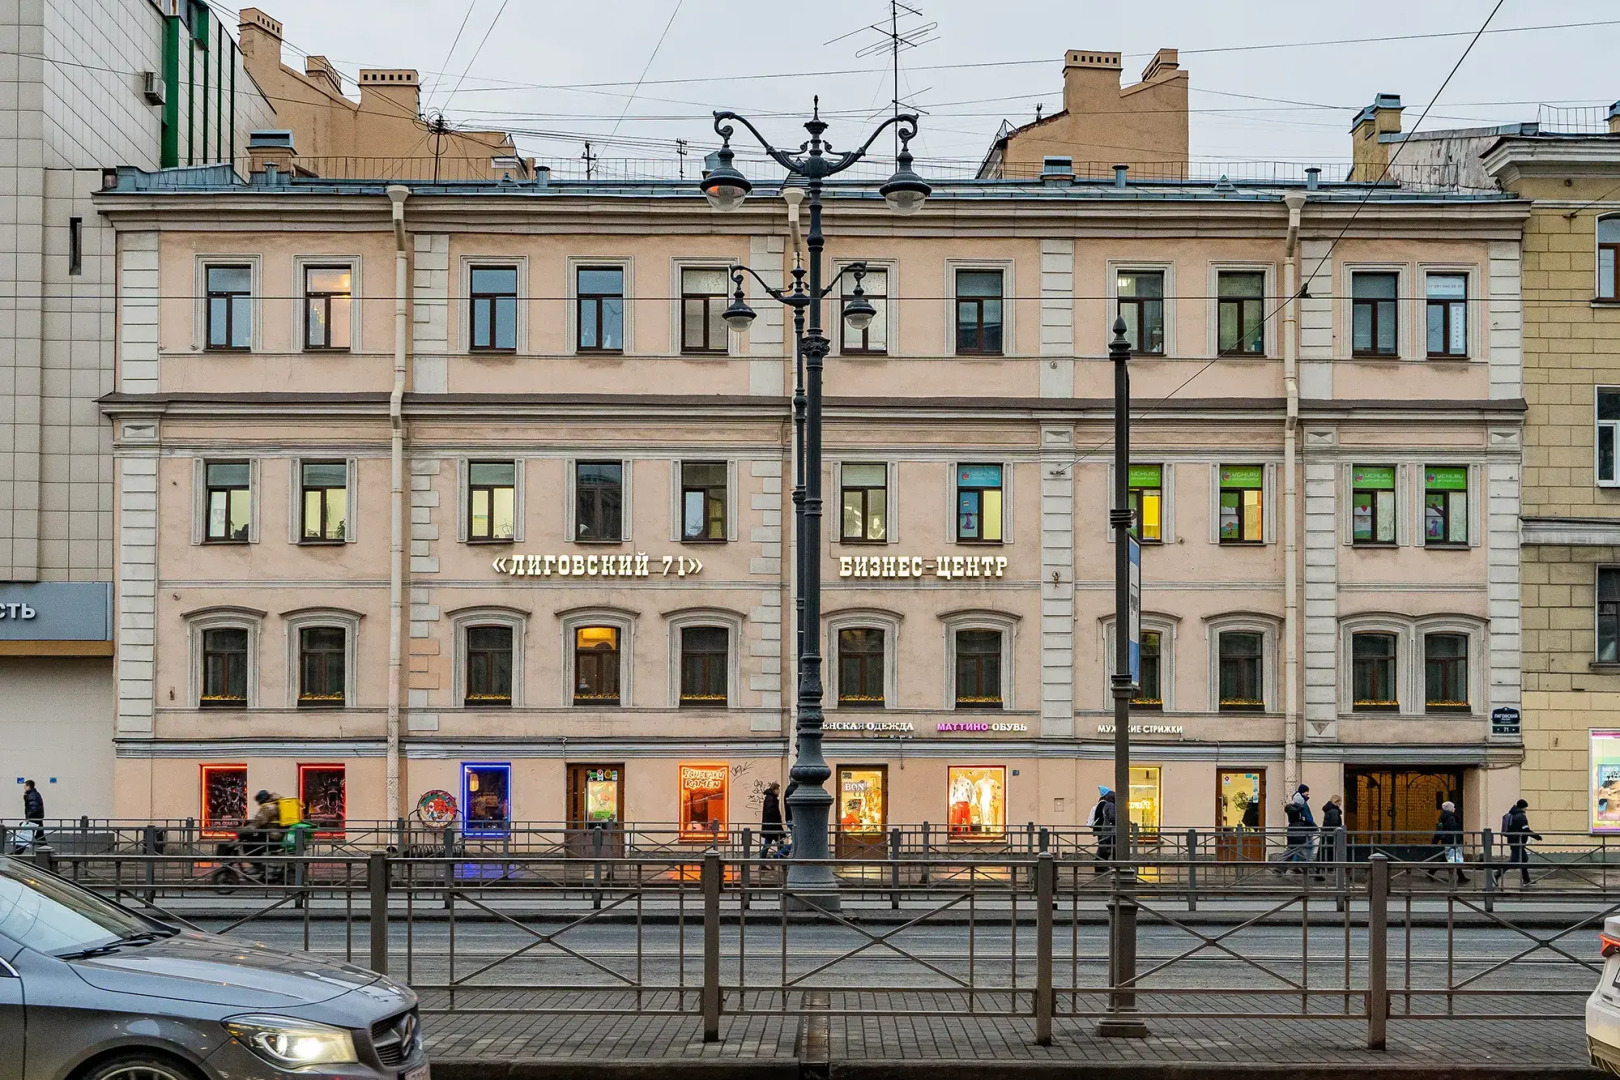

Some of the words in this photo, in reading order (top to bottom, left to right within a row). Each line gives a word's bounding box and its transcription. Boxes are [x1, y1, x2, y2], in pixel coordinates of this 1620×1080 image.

[492, 552, 649, 577] «ЛИГОВСКИЙ
[662, 555, 703, 577] 71»
[839, 556, 1008, 580] БИЗНЕС-ЦЕНТР
[820, 722, 865, 730] ЕНСКАЯ
[866, 722, 914, 732] ОДЕЖДА
[937, 723, 988, 731] МАТТИНО
[991, 723, 1028, 731] ОБУВЬ
[1142, 724, 1183, 733] СТРИЖКИ
[685, 780, 720, 789] RAMEN
